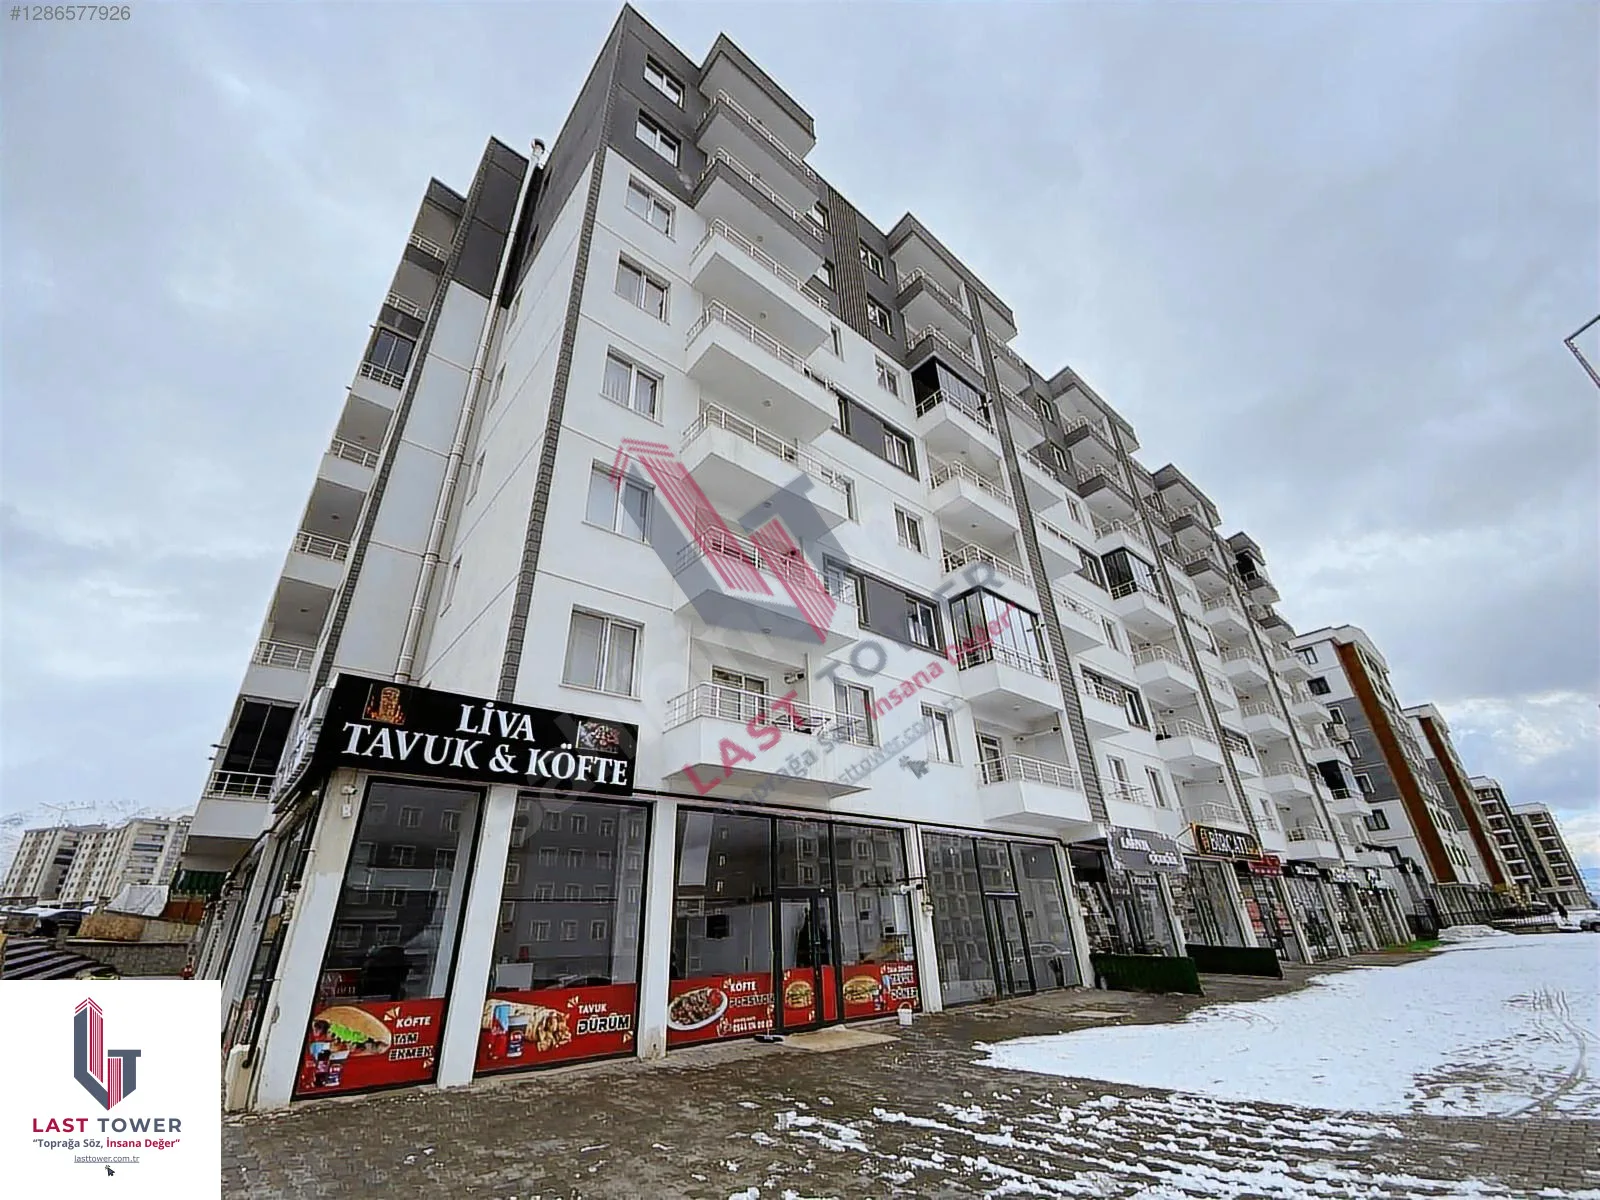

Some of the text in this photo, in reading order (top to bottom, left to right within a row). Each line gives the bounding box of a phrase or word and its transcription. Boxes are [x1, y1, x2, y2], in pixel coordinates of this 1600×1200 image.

[456, 702, 535, 741] LİVA
[342, 722, 479, 771] TAVUK
[489, 744, 517, 774] &
[526, 743, 628, 786] KÖFTE
[730, 979, 757, 992] KÖFTE
[578, 1003, 607, 1014] TAVUK
[395, 1015, 432, 1028] KÖFTE
[577, 1013, 631, 1035] DÜRÜM
[393, 1032, 419, 1044] TAM
[388, 1045, 434, 1061] EKMEK
